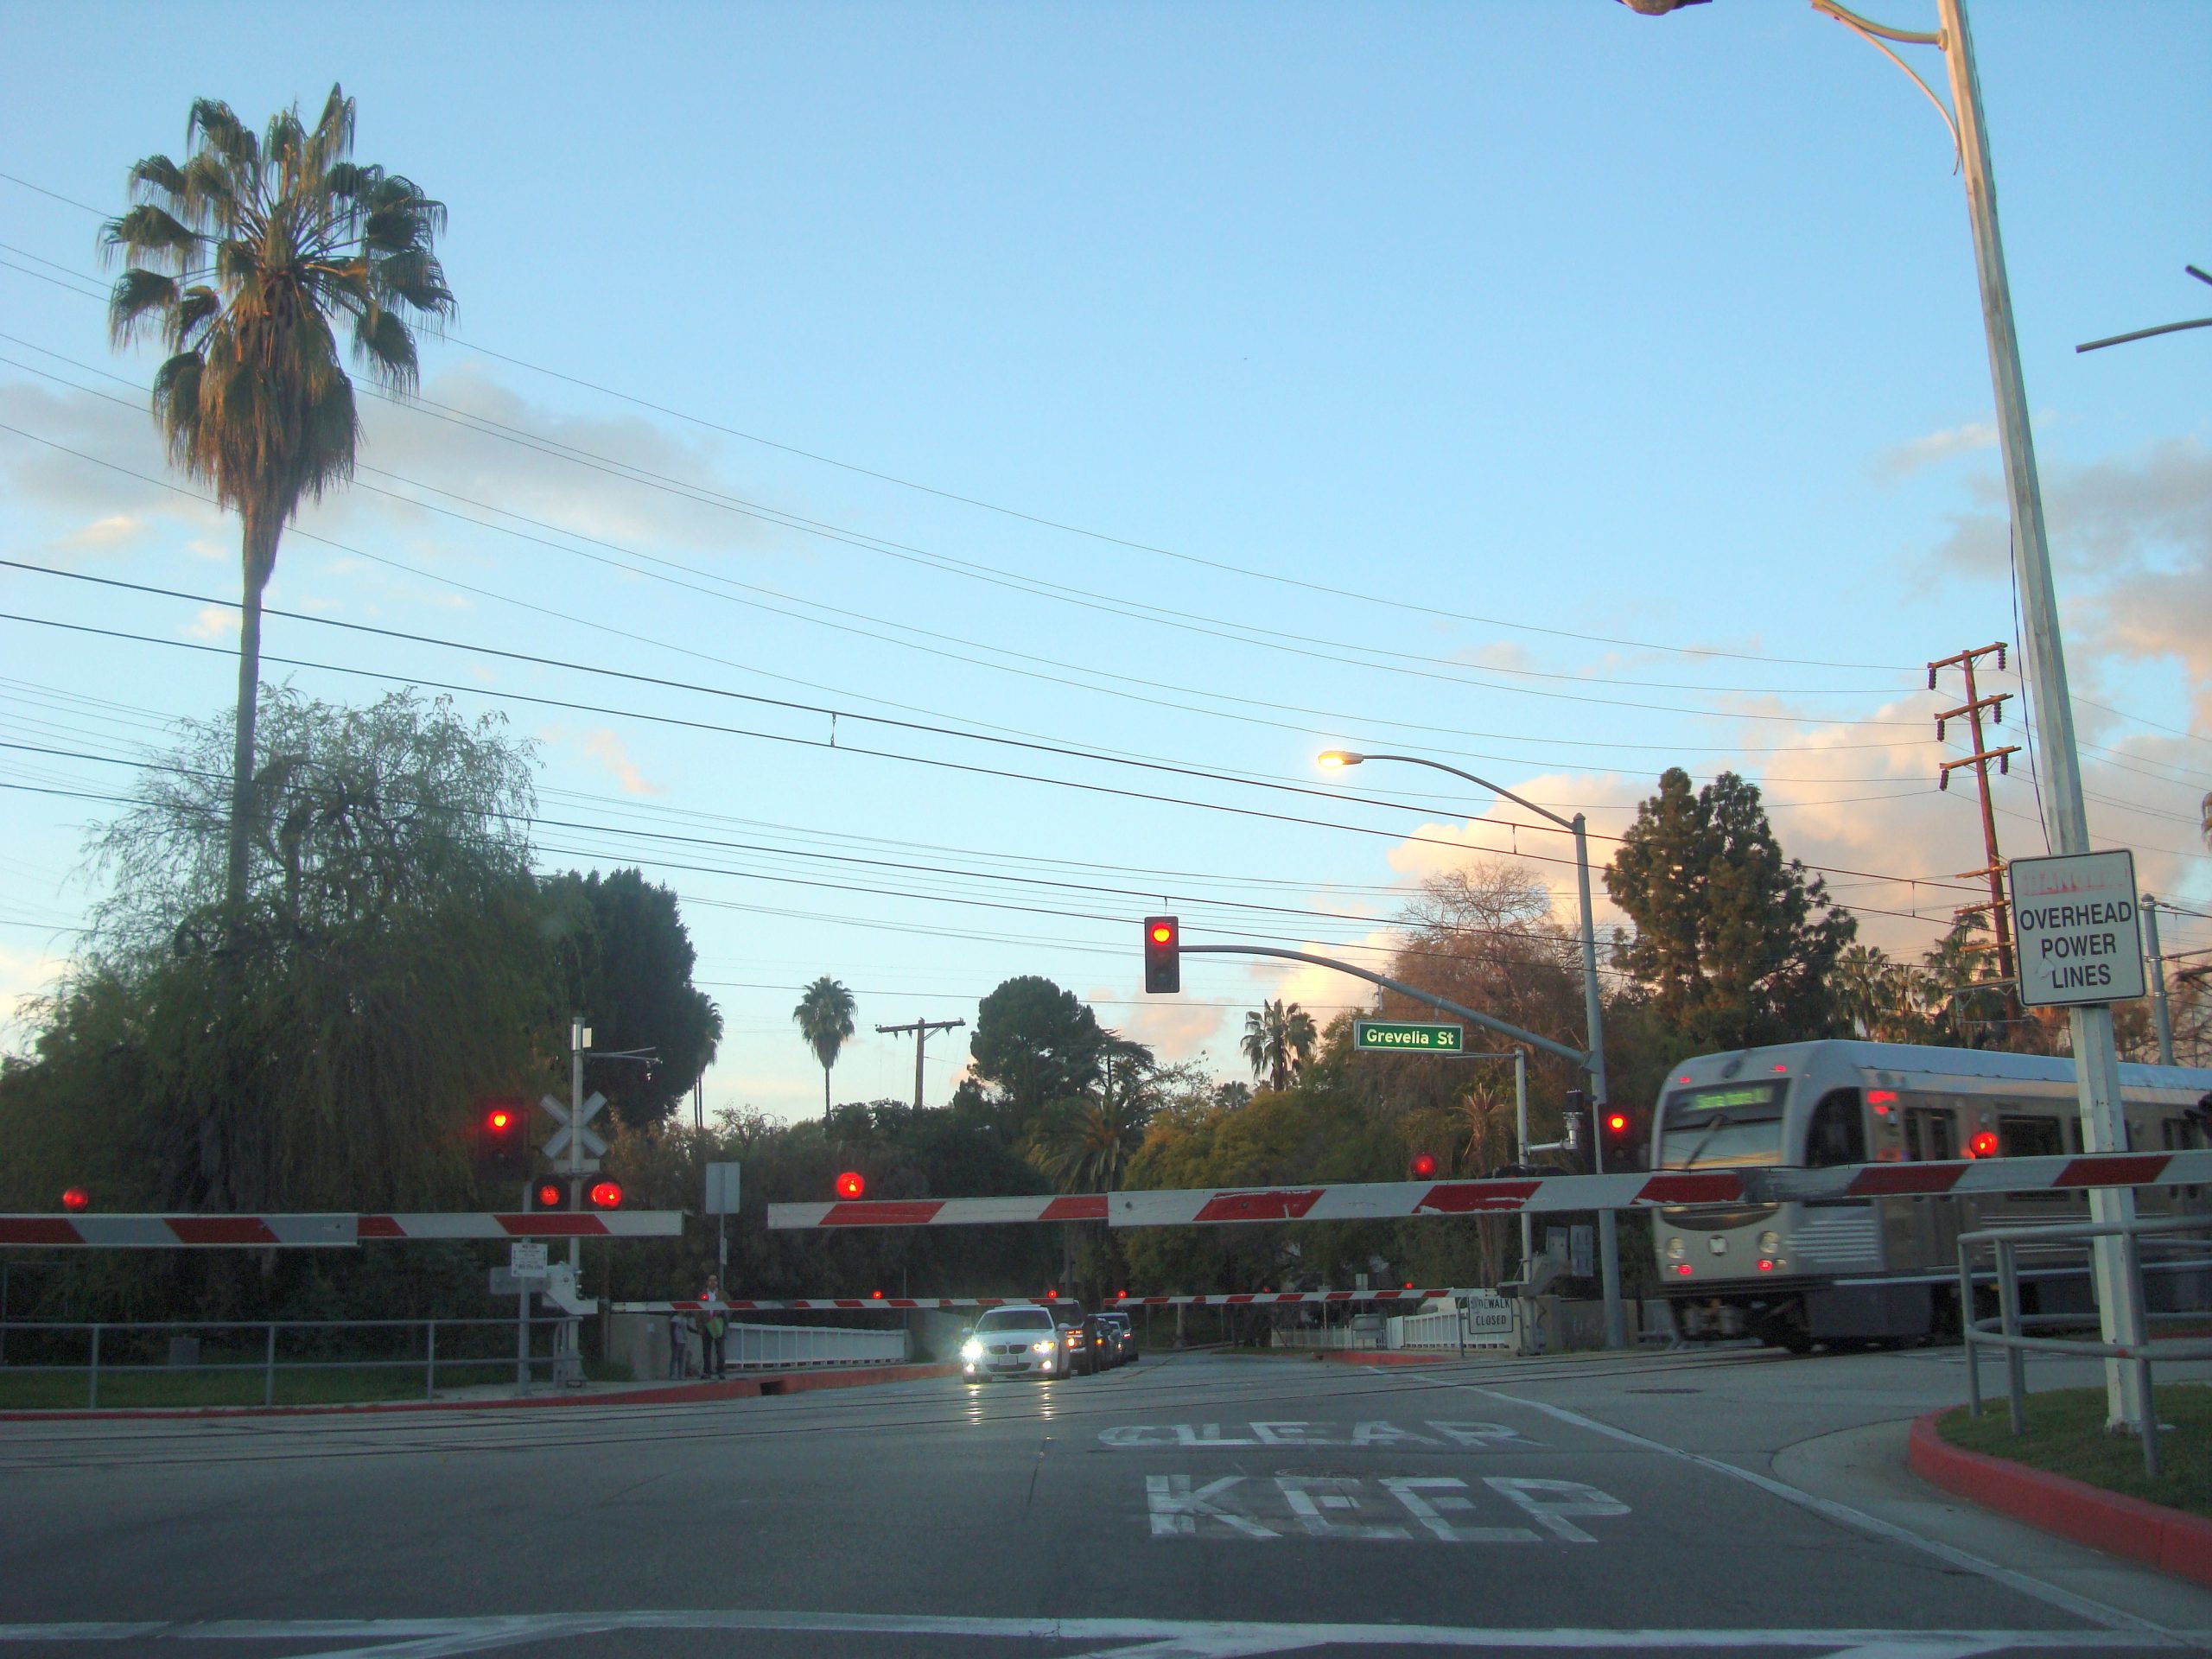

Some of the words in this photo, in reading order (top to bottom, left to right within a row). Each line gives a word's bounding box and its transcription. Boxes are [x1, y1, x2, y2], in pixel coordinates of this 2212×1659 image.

[2019, 901, 2133, 931] OVERHEAD
[2041, 933, 2117, 959] POWER
[2051, 963, 2112, 988] LINES
[1366, 1028, 1429, 1045] Grevelia
[1437, 1031, 1454, 1046] St
[1470, 1297, 1510, 1309] SDEWALK
[1476, 1314, 1506, 1326] CLOSED
[1097, 1420, 1555, 1447] CLEAR
[1146, 1472, 1633, 1544] KEEP
